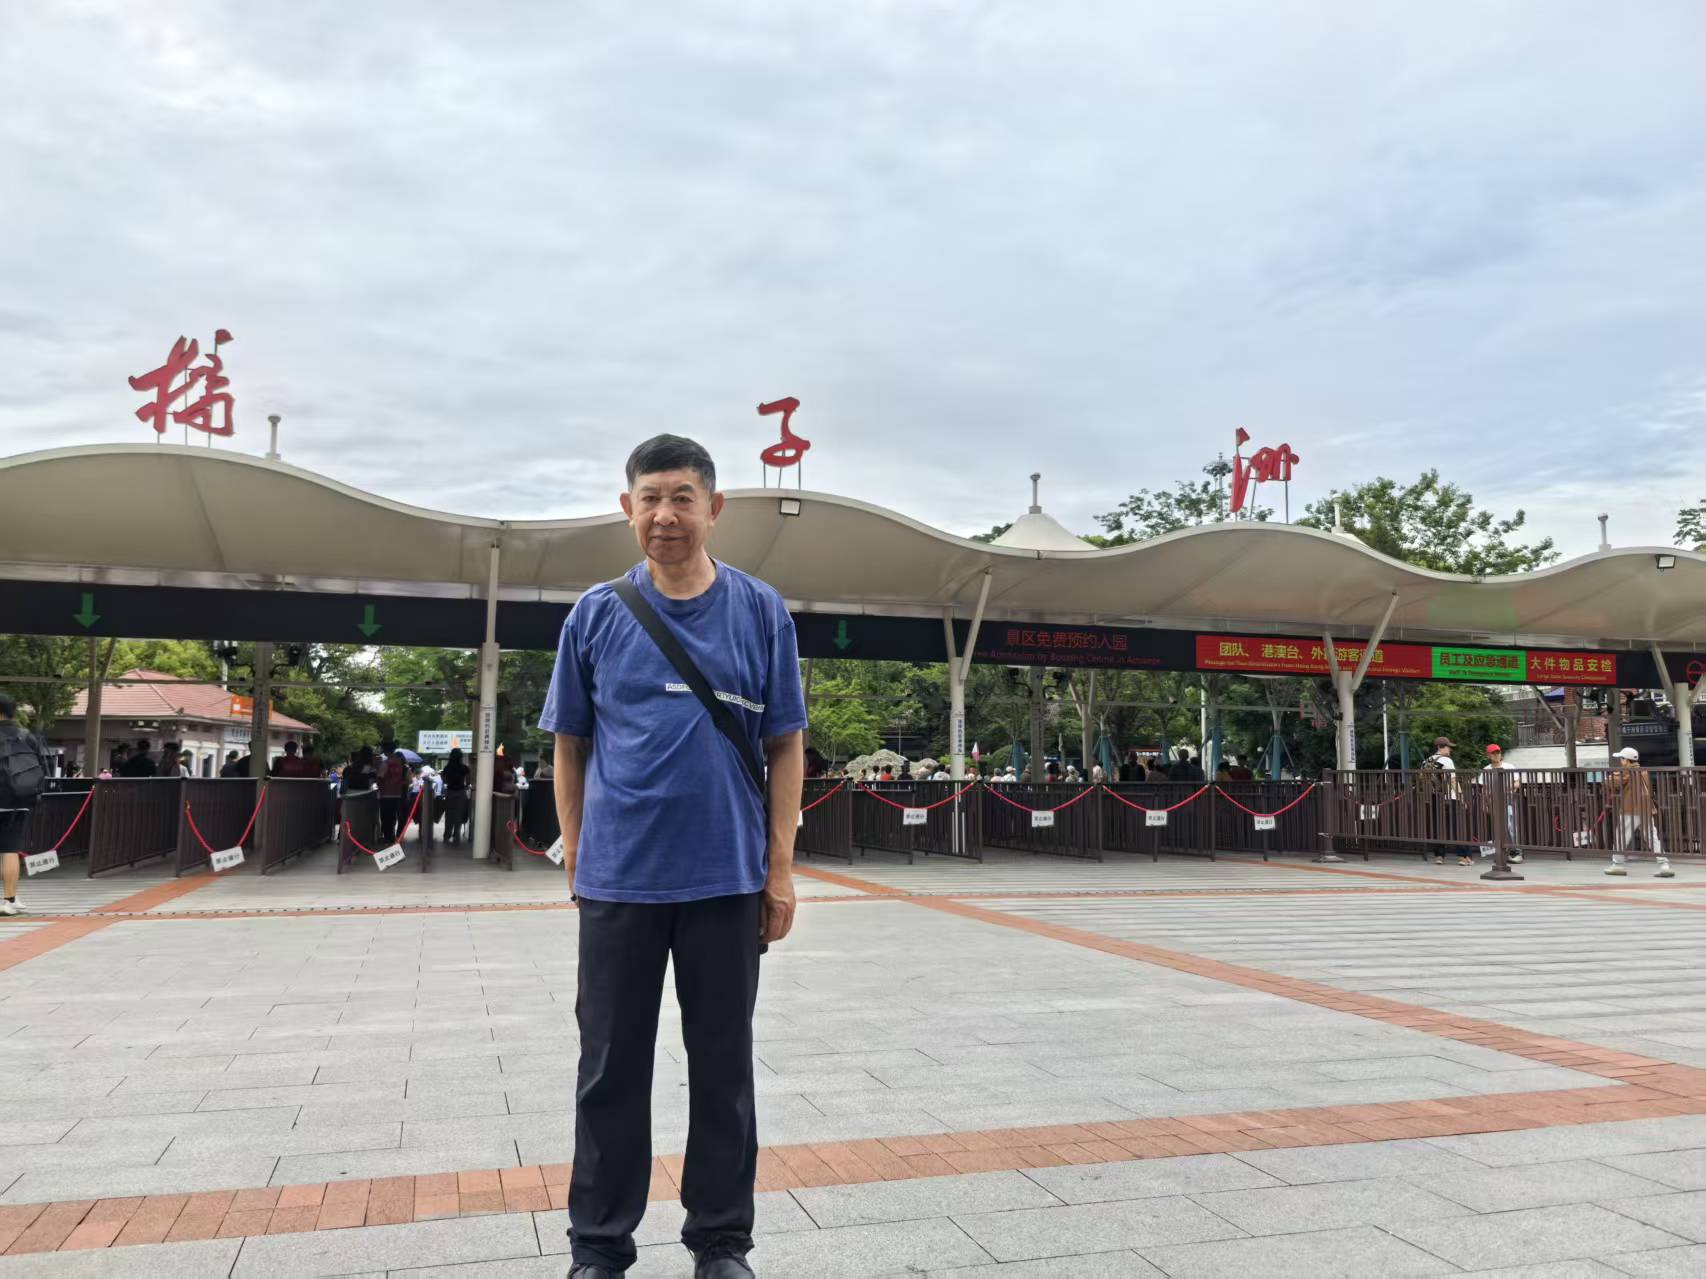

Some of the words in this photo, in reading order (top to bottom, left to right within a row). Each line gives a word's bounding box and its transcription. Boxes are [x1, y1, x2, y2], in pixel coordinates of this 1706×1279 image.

[128, 329, 235, 437] 橘
[756, 396, 811, 468] 子
[1007, 629, 1129, 651] 景区免费预约入园
[1530, 656, 1612, 673] 大件物品安检
